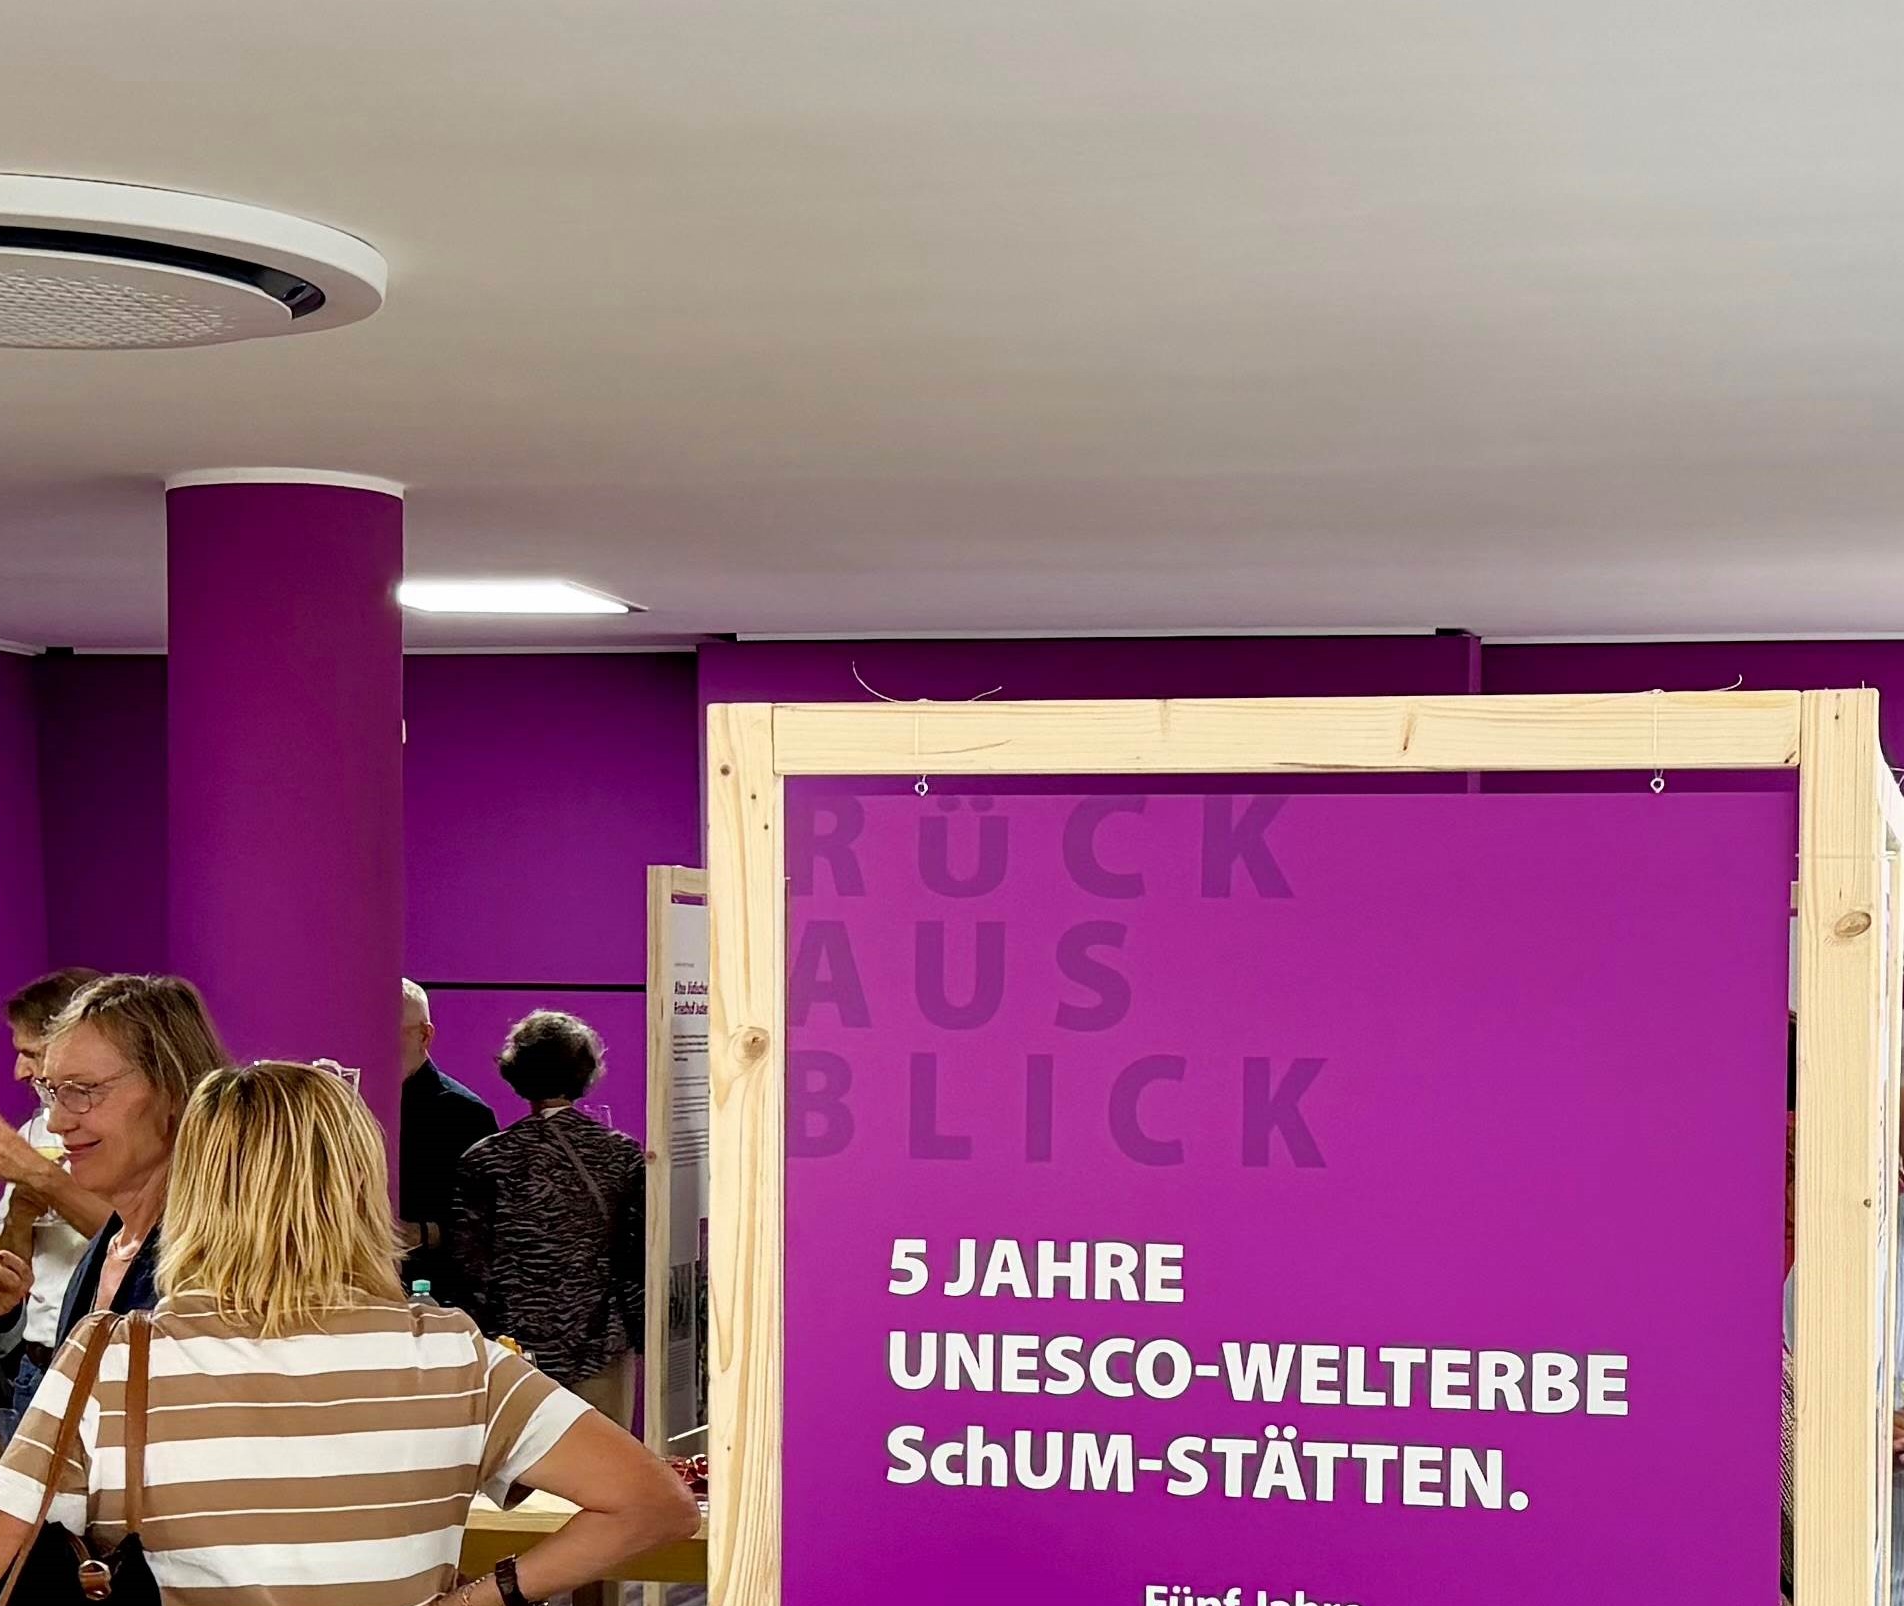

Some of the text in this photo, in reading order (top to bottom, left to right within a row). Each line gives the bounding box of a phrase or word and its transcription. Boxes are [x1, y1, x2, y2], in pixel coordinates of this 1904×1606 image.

[793, 795, 1296, 899] RÜCK
[793, 920, 1132, 1033] AUS
[788, 1050, 1329, 1169] BLICK
[888, 1238, 1184, 1303] 5 JAHRE
[889, 1330, 1629, 1416] UNESCO-WELTERBE
[886, 1424, 1529, 1511] SchUM-STÄTTEN.
